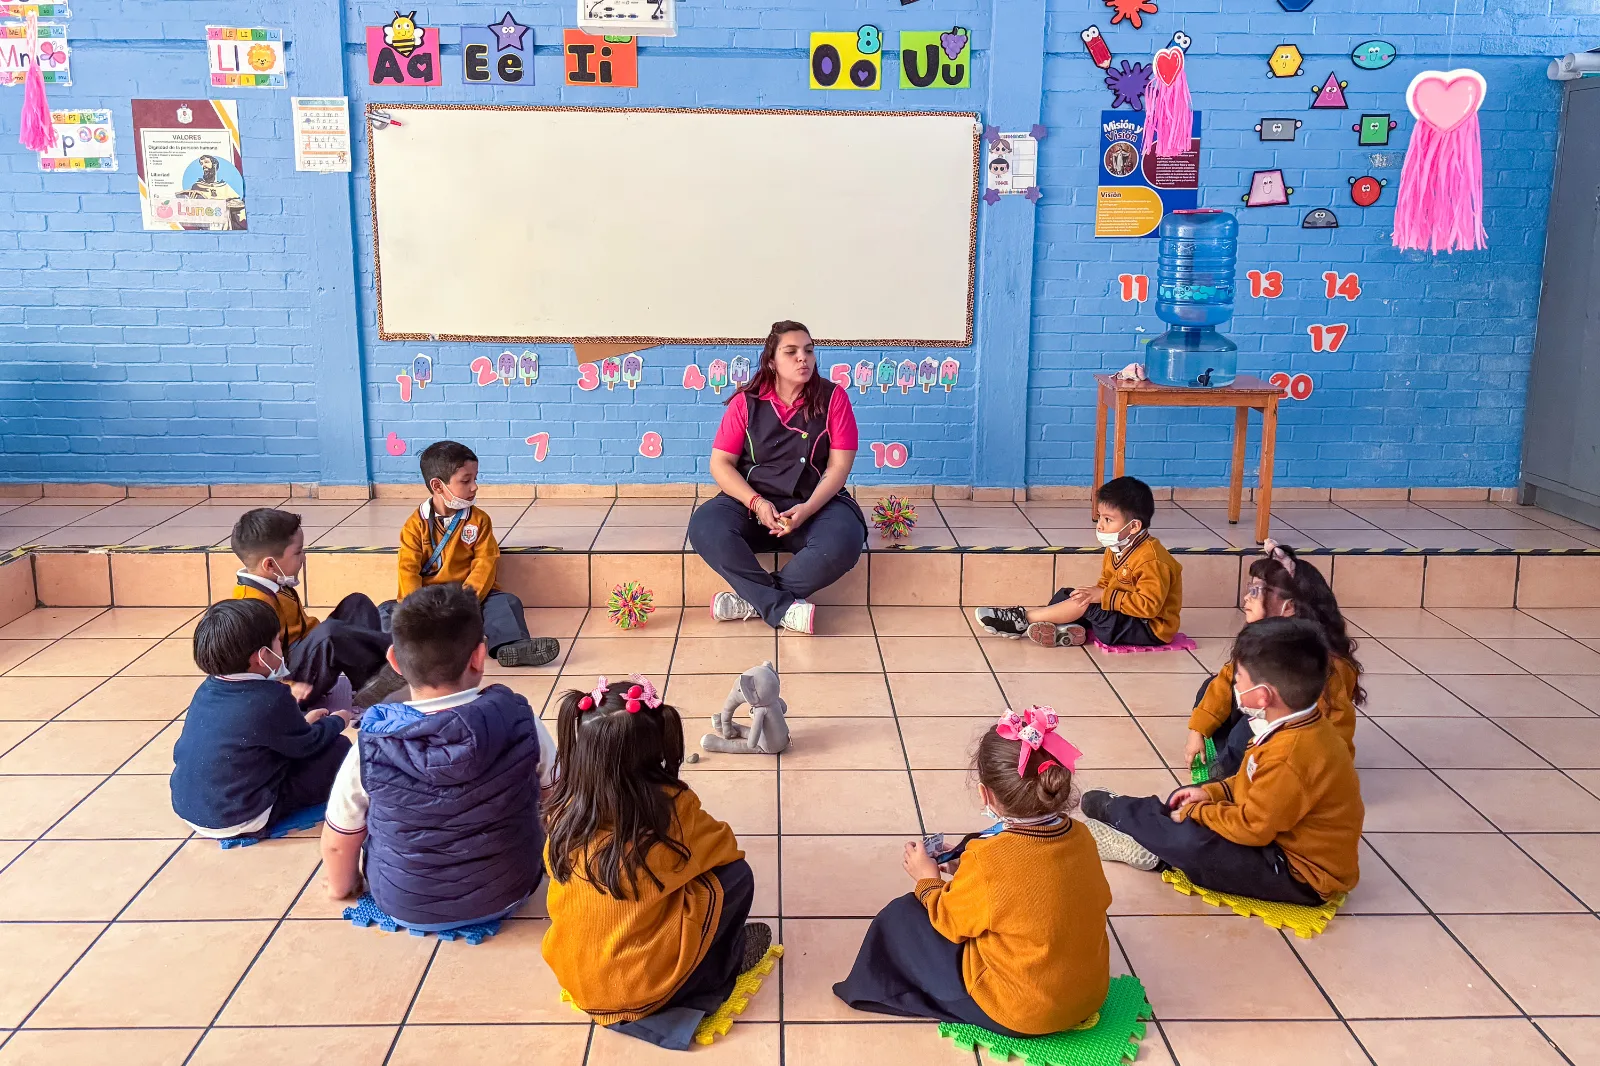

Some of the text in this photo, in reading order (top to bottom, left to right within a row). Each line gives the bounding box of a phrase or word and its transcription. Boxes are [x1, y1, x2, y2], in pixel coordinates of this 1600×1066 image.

[858, 25, 880, 54] 8
[373, 47, 433, 84] Aa
[464, 44, 523, 83] Ee
[567, 44, 613, 83] Ii
[812, 43, 877, 88] Oo
[902, 44, 965, 87] Uu
[1103, 118, 1144, 134] Misión y
[1105, 129, 1138, 142] Visión
[177, 202, 222, 217] Lunes
[1118, 274, 1149, 302] 11
[1246, 270, 1284, 298] 13
[1322, 271, 1361, 301] 14
[1308, 324, 1348, 352] 17
[471, 357, 499, 386] 2
[578, 363, 599, 390] 3
[683, 364, 706, 390] 4
[830, 364, 851, 389] 5
[396, 375, 412, 402] 1
[1270, 373, 1312, 400] 20
[386, 432, 407, 456] 6
[525, 433, 550, 462] 7
[640, 432, 663, 458] 8
[870, 442, 908, 468] 10
